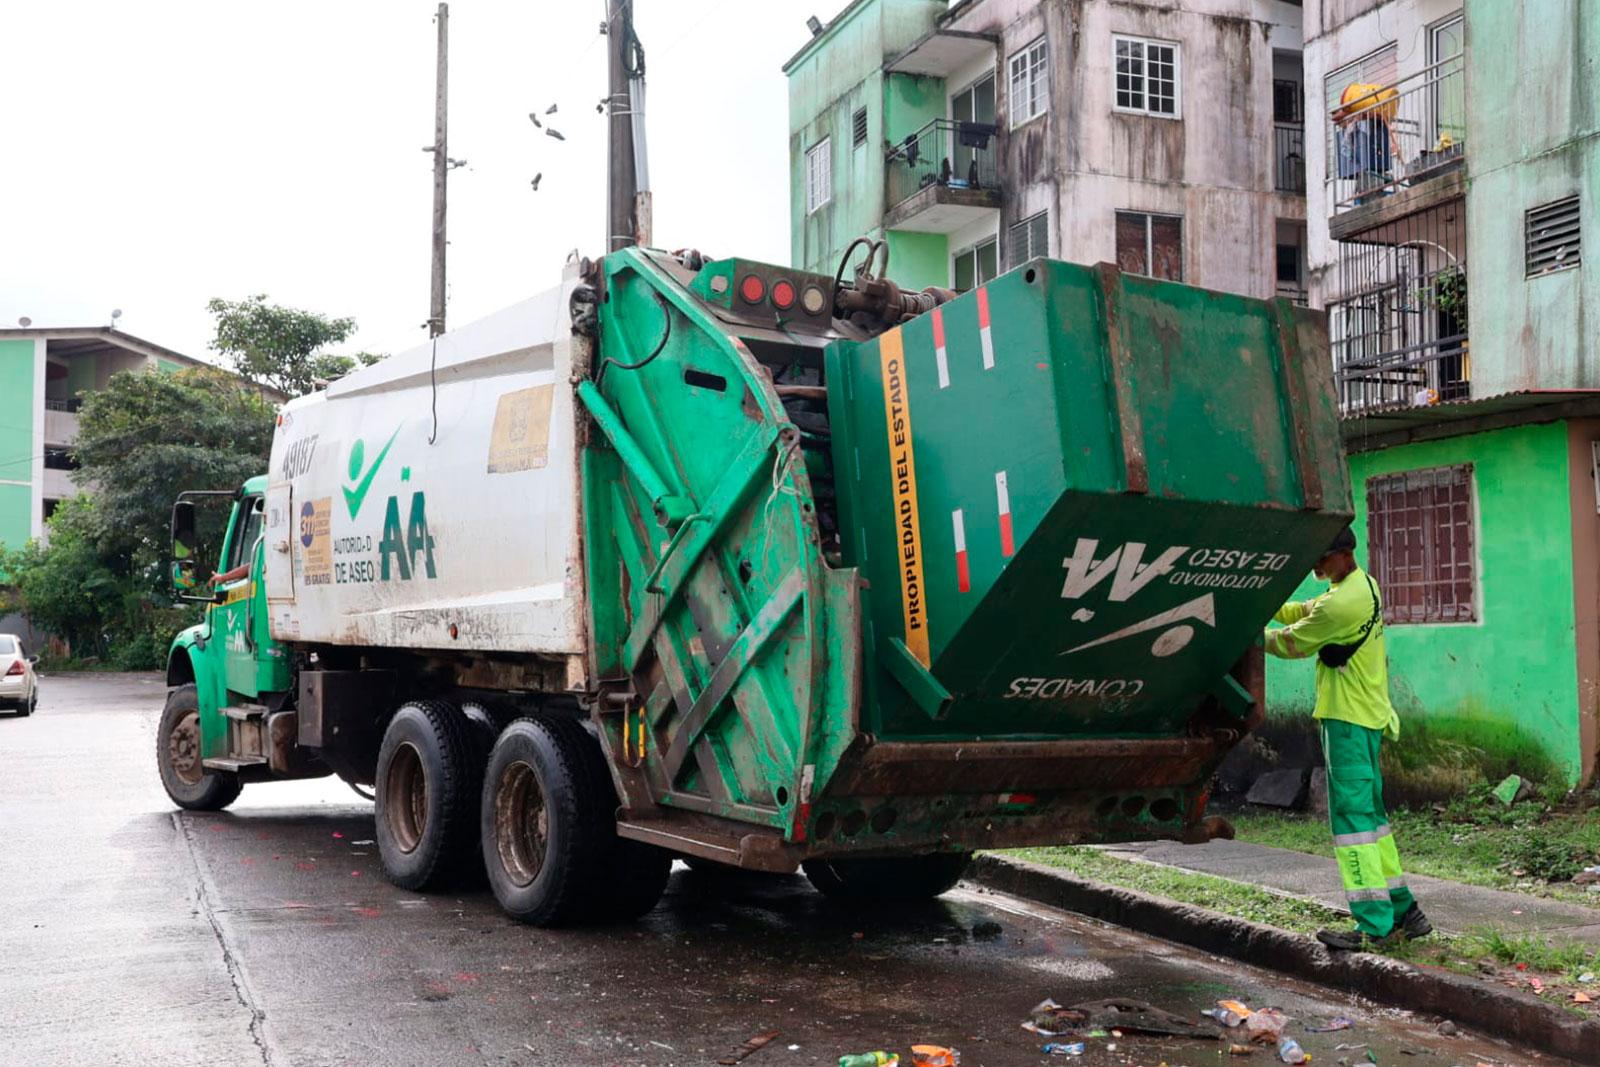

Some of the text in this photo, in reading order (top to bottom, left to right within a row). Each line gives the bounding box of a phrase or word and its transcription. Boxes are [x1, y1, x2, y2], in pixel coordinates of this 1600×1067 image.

[282, 433, 320, 481] 49187
[887, 358, 922, 631] PROPIEDAD DEL ESTADO
[335, 562, 348, 584] DE
[348, 560, 375, 583] ASEO
[1187, 548, 1291, 572] DE ASEO
[1168, 570, 1273, 589] AUTORIDAD
[1004, 676, 1145, 699] CONADES
